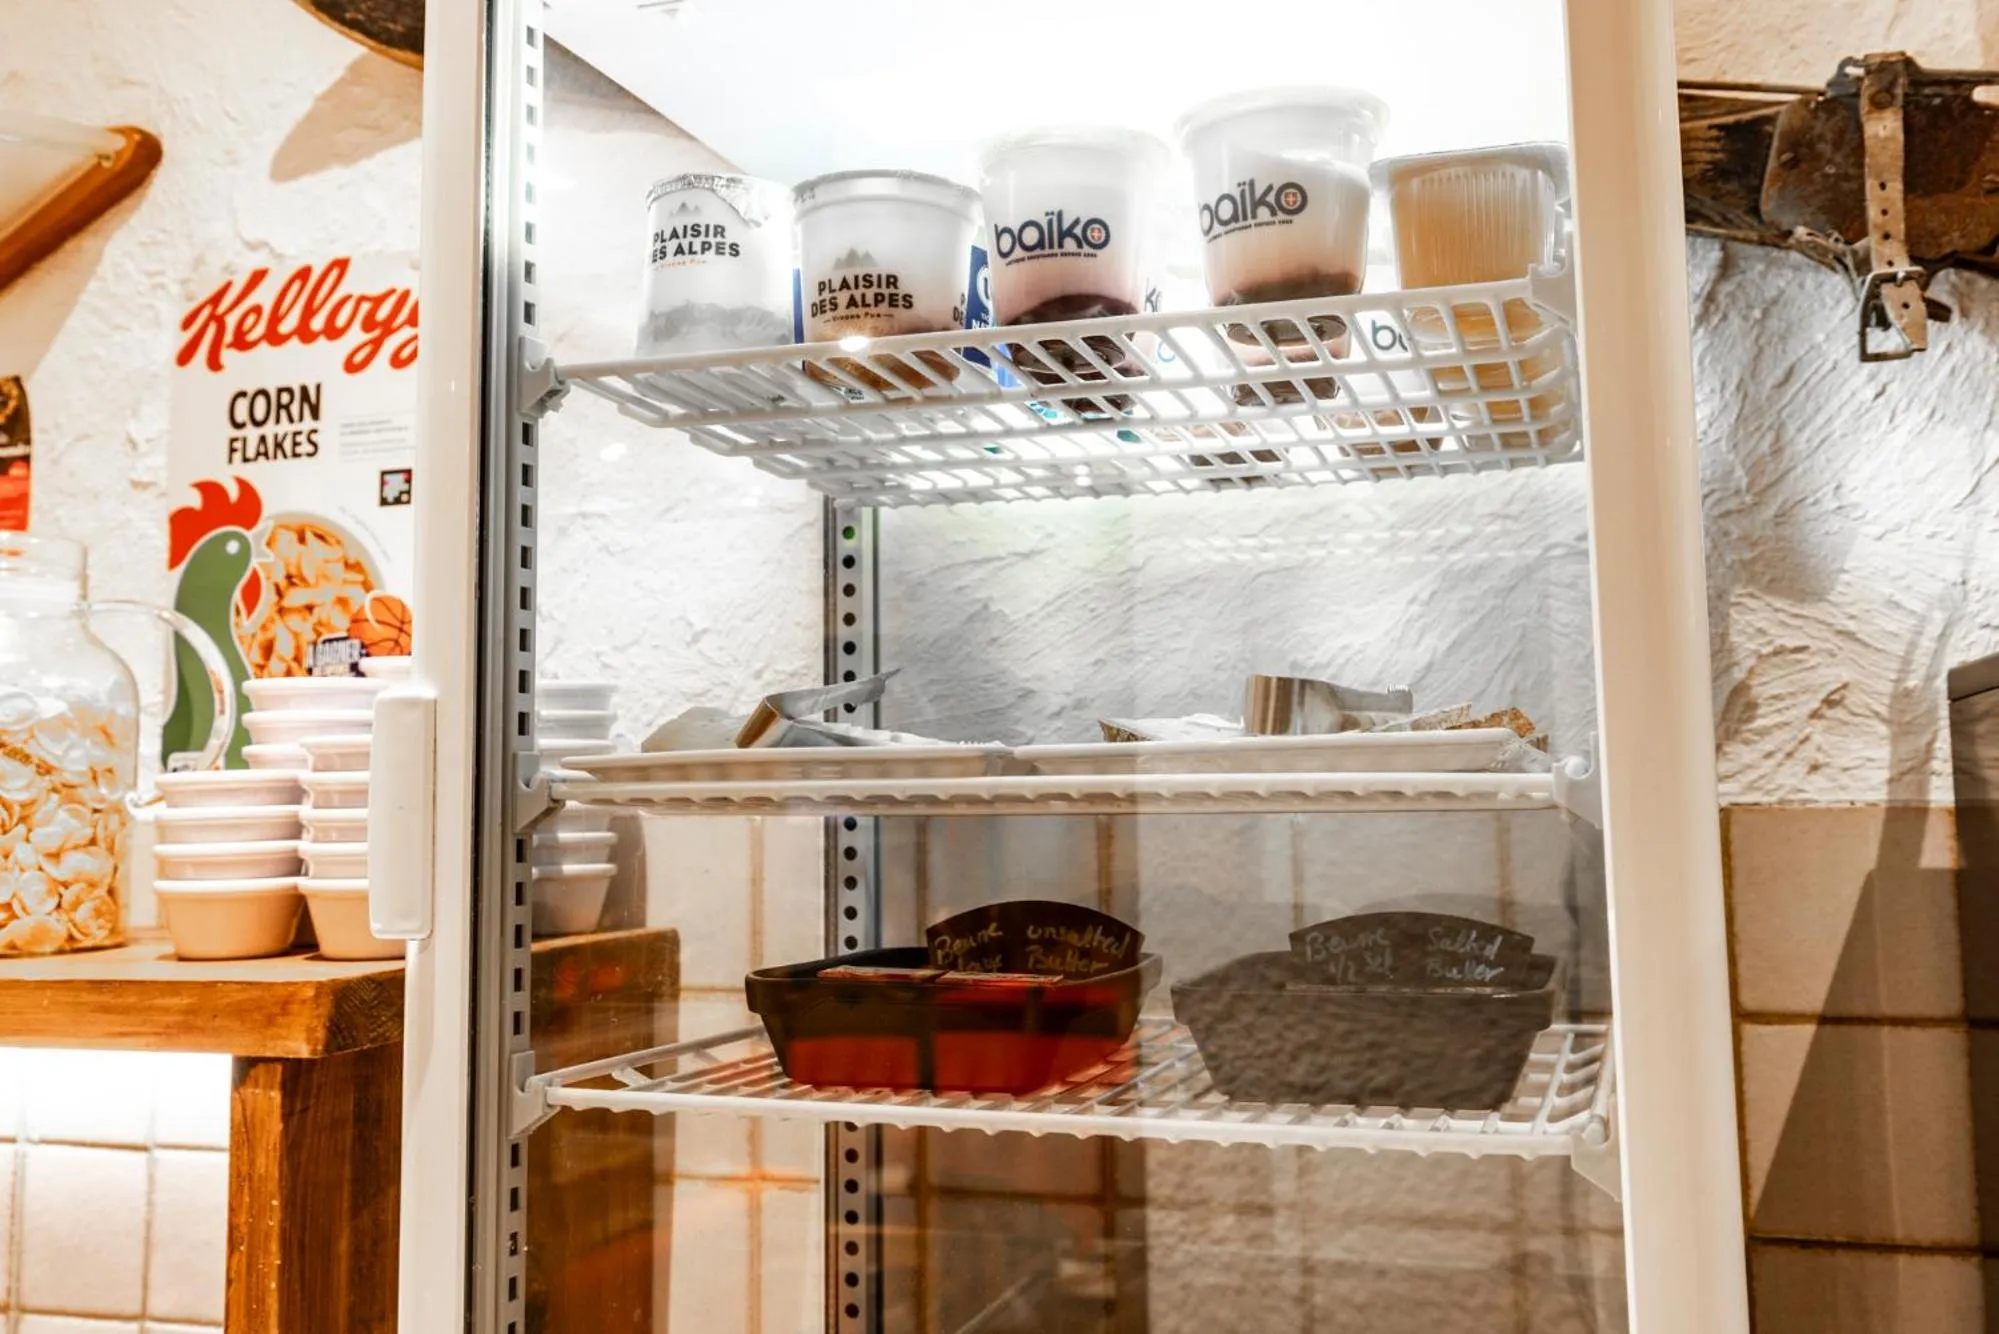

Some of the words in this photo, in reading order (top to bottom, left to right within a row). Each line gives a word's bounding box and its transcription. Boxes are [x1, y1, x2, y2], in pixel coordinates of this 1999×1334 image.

[653, 223, 726, 247] PLAISIR
[994, 208, 1111, 260] baïko
[652, 244, 667, 263] ES
[673, 240, 741, 258] ALPES
[817, 273, 900, 297] PLAISIR
[810, 295, 839, 318] DES
[845, 292, 914, 310] ALPES
[228, 383, 321, 430] CORN
[228, 428, 320, 465] FLAKES
